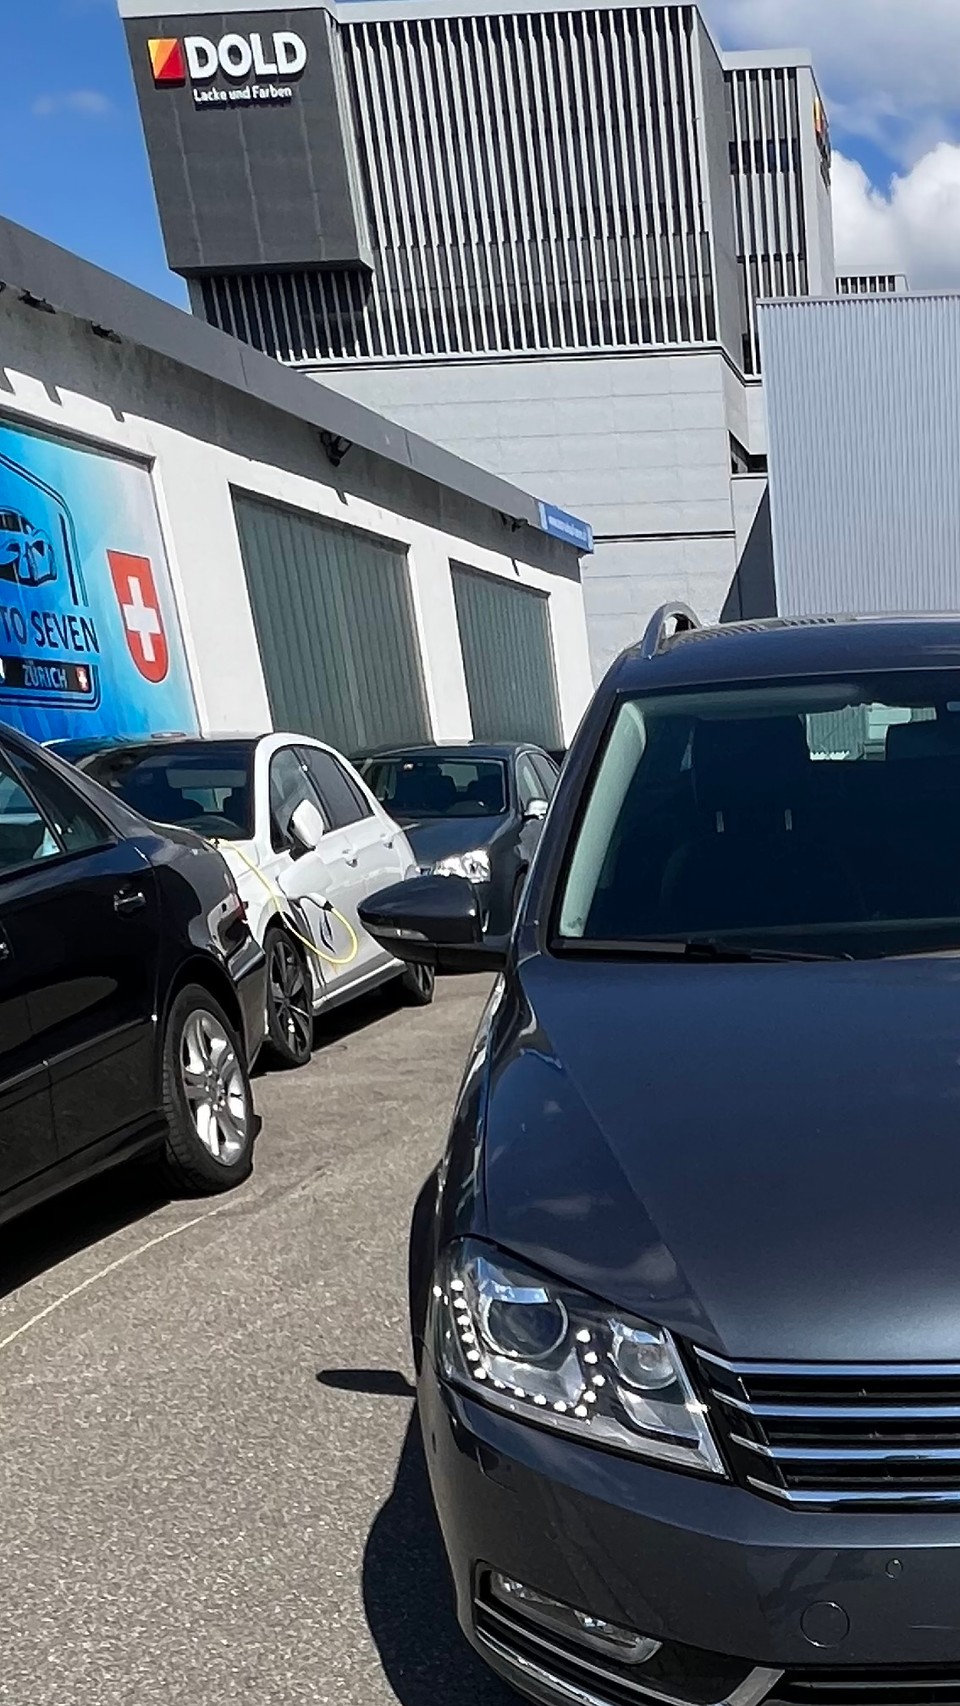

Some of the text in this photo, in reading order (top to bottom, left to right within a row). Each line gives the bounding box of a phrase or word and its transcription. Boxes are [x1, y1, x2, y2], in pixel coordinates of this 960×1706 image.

[185, 32, 307, 79] DOLD
[193, 84, 293, 102] Lacke und Farben
[31, 610, 100, 653] SEVEN
[22, 660, 68, 688] ZÜRICH
